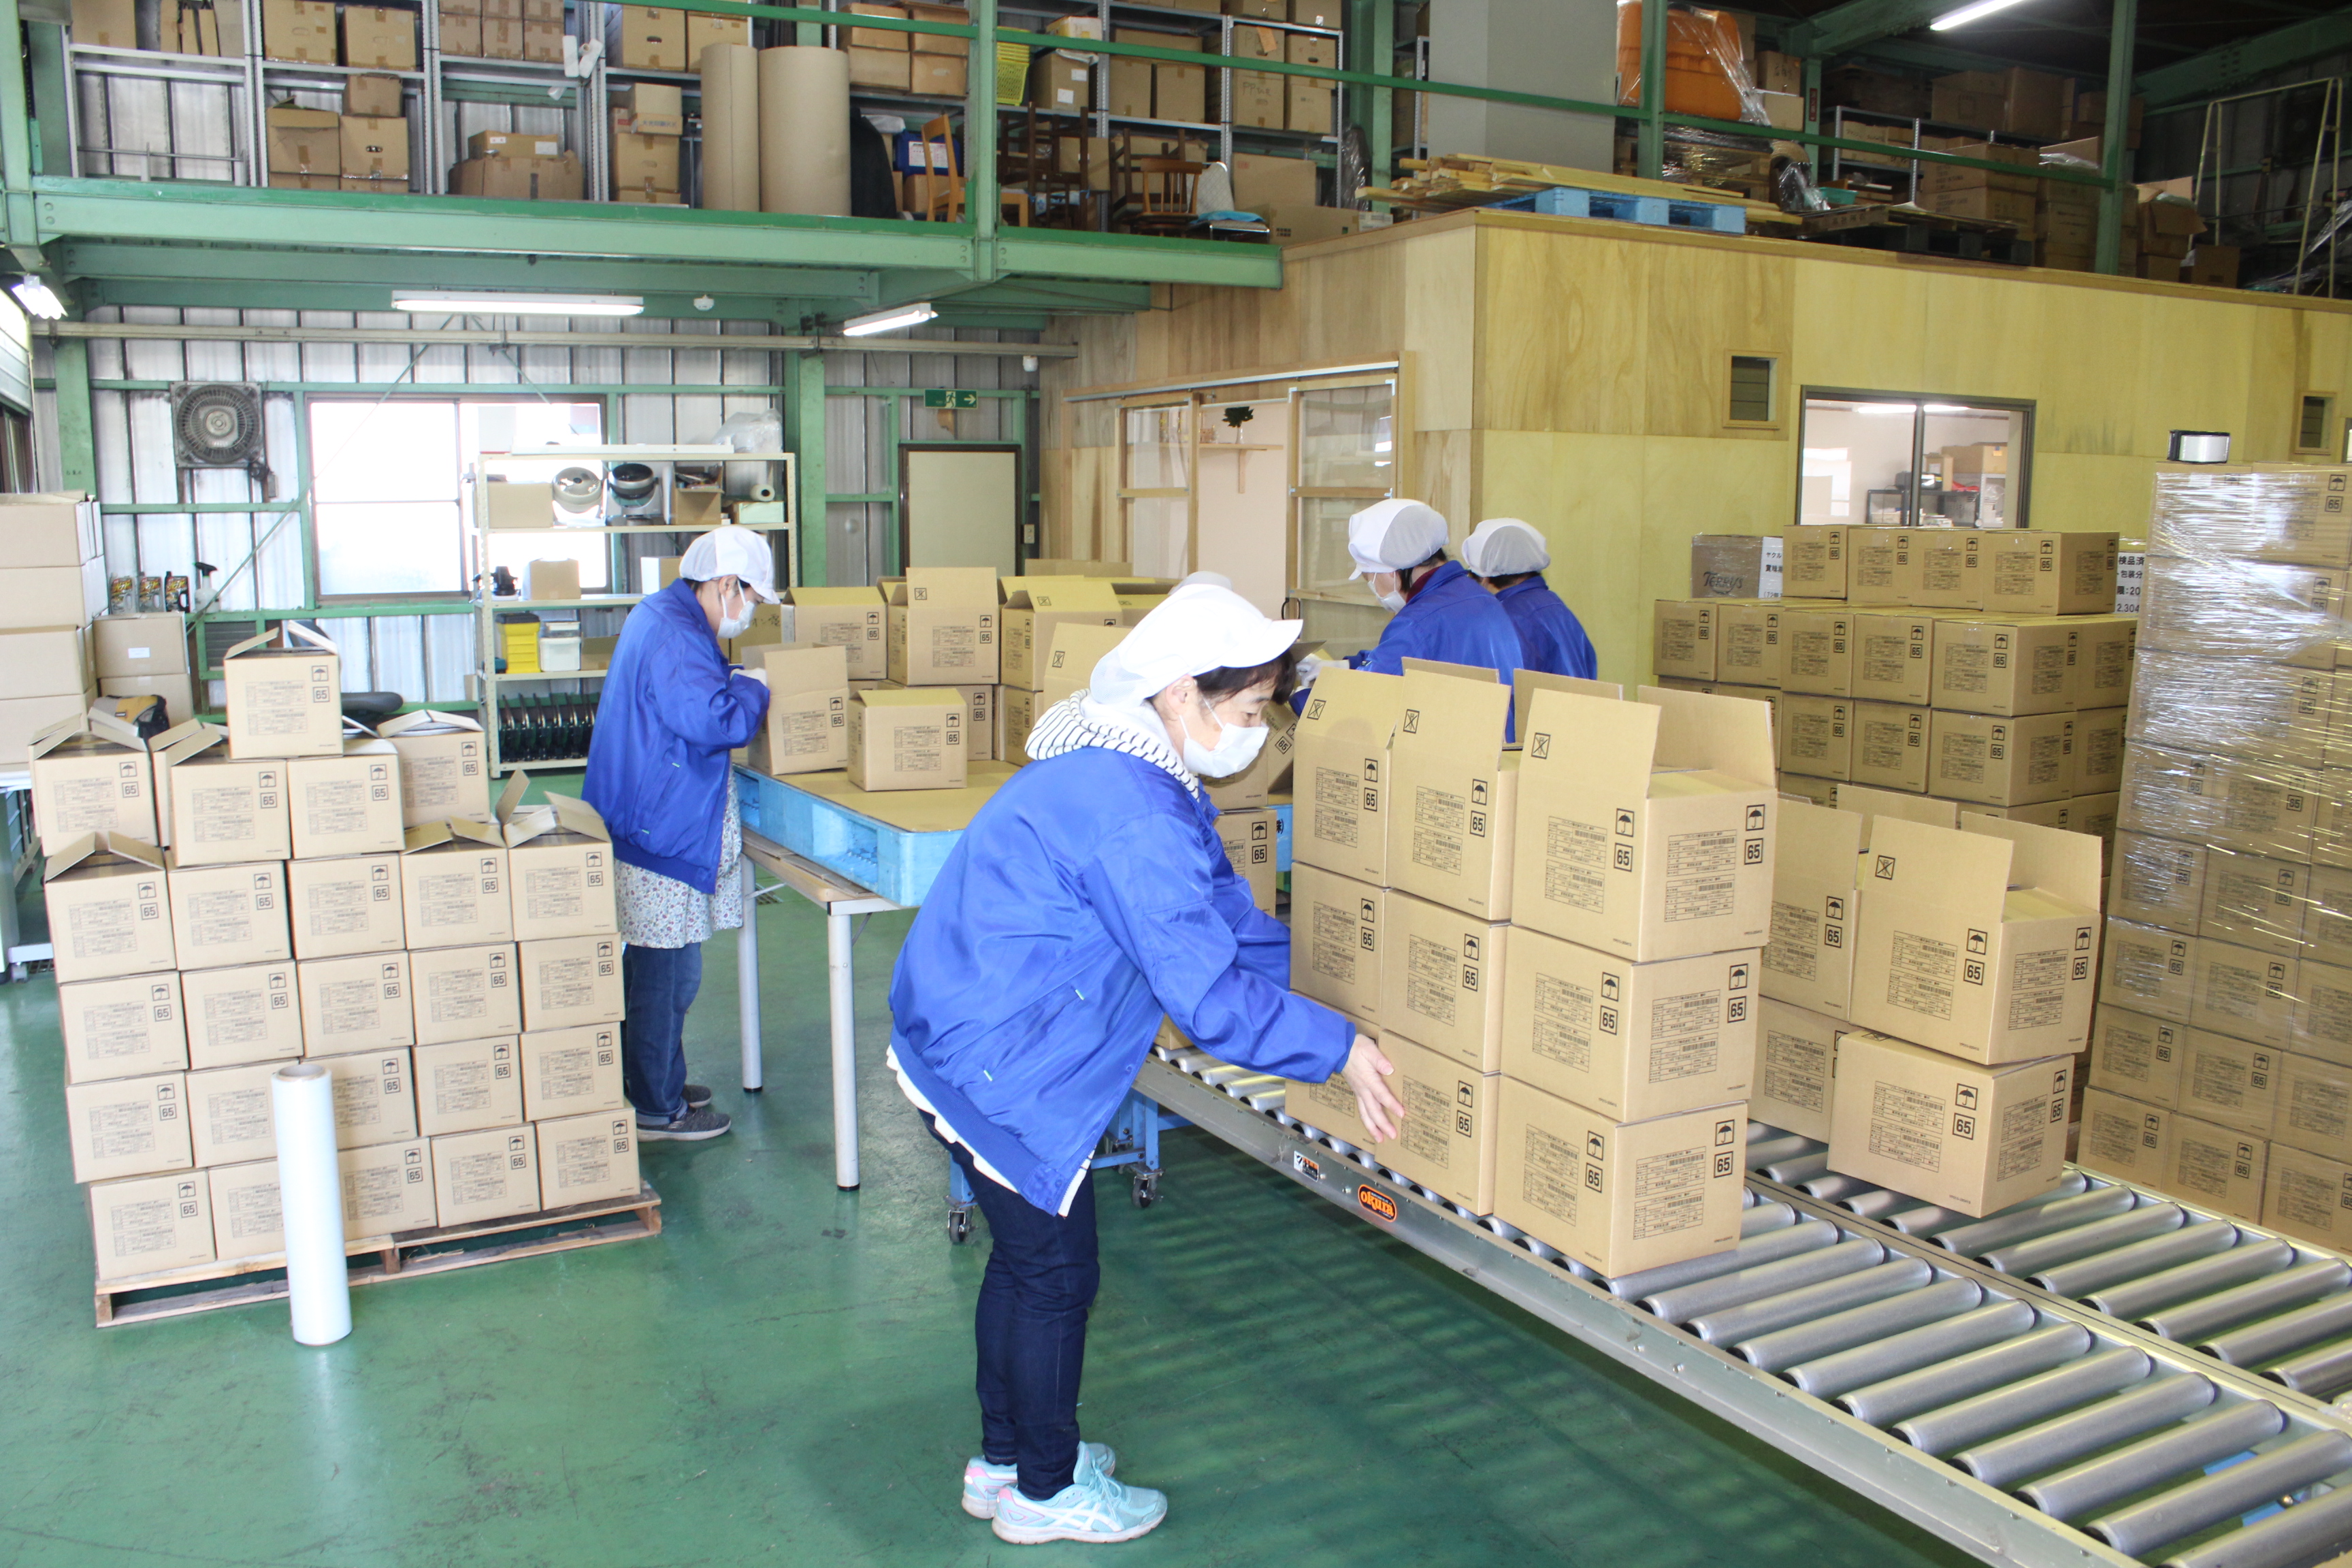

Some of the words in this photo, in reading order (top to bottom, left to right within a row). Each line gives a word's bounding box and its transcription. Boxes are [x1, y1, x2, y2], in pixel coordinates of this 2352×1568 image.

[2328, 500, 2340, 509] 65
[2117, 570, 2142, 578] 包装分
[1767, 634, 1776, 642] 65
[1912, 647, 1921, 655] 65
[1995, 656, 2005, 665] 65
[316, 690, 327, 700] 65
[833, 717, 842, 725] 65
[1834, 725, 1842, 734] 65
[949, 734, 958, 742] 65
[1910, 735, 1918, 744] 65
[1278, 740, 1288, 751] 65
[1993, 747, 2001, 756] 65
[466, 764, 476, 773] 65
[125, 785, 136, 795] 65
[374, 788, 386, 798] 65
[263, 796, 275, 805] 65
[1366, 793, 1375, 806] 65
[1473, 817, 1483, 832] 65
[1254, 849, 1264, 860] 65
[1748, 844, 1760, 860] 65
[1617, 849, 1629, 866] 65
[590, 875, 601, 883] 65
[485, 881, 495, 890] 65
[376, 888, 387, 898] 65
[259, 897, 271, 906] 65
[144, 906, 156, 917] 65
[1363, 932, 1372, 946] 65
[1827, 930, 1839, 943] 65
[601, 964, 611, 973] 65
[1967, 964, 1980, 980] 65
[2075, 962, 2085, 975] 65
[2171, 962, 2181, 972] 65
[493, 975, 504, 985] 65
[1465, 970, 1475, 986] 65
[387, 986, 397, 996] 65
[274, 996, 285, 1006] 65
[157, 1008, 169, 1018] 65
[1731, 1002, 1743, 1017] 65
[1603, 1012, 1614, 1029] 65
[600, 1054, 610, 1062] 65
[2159, 1049, 2168, 1058] 65
[497, 1066, 508, 1076] 65
[2253, 1075, 2264, 1085] 65
[387, 1081, 398, 1091] 65
[162, 1107, 174, 1117] 65
[2053, 1104, 2061, 1117] 65
[1459, 1116, 1469, 1132] 65
[1957, 1119, 1971, 1134] 65
[2145, 1135, 2155, 1145] 65
[617, 1141, 627, 1150] 65
[513, 1157, 523, 1166] 65
[1717, 1157, 1730, 1173] 65
[2237, 1164, 2247, 1175] 65
[410, 1171, 421, 1180] 65
[1588, 1170, 1599, 1186] 65
[1360, 1191, 1394, 1217] okura
[183, 1205, 195, 1215] 65
